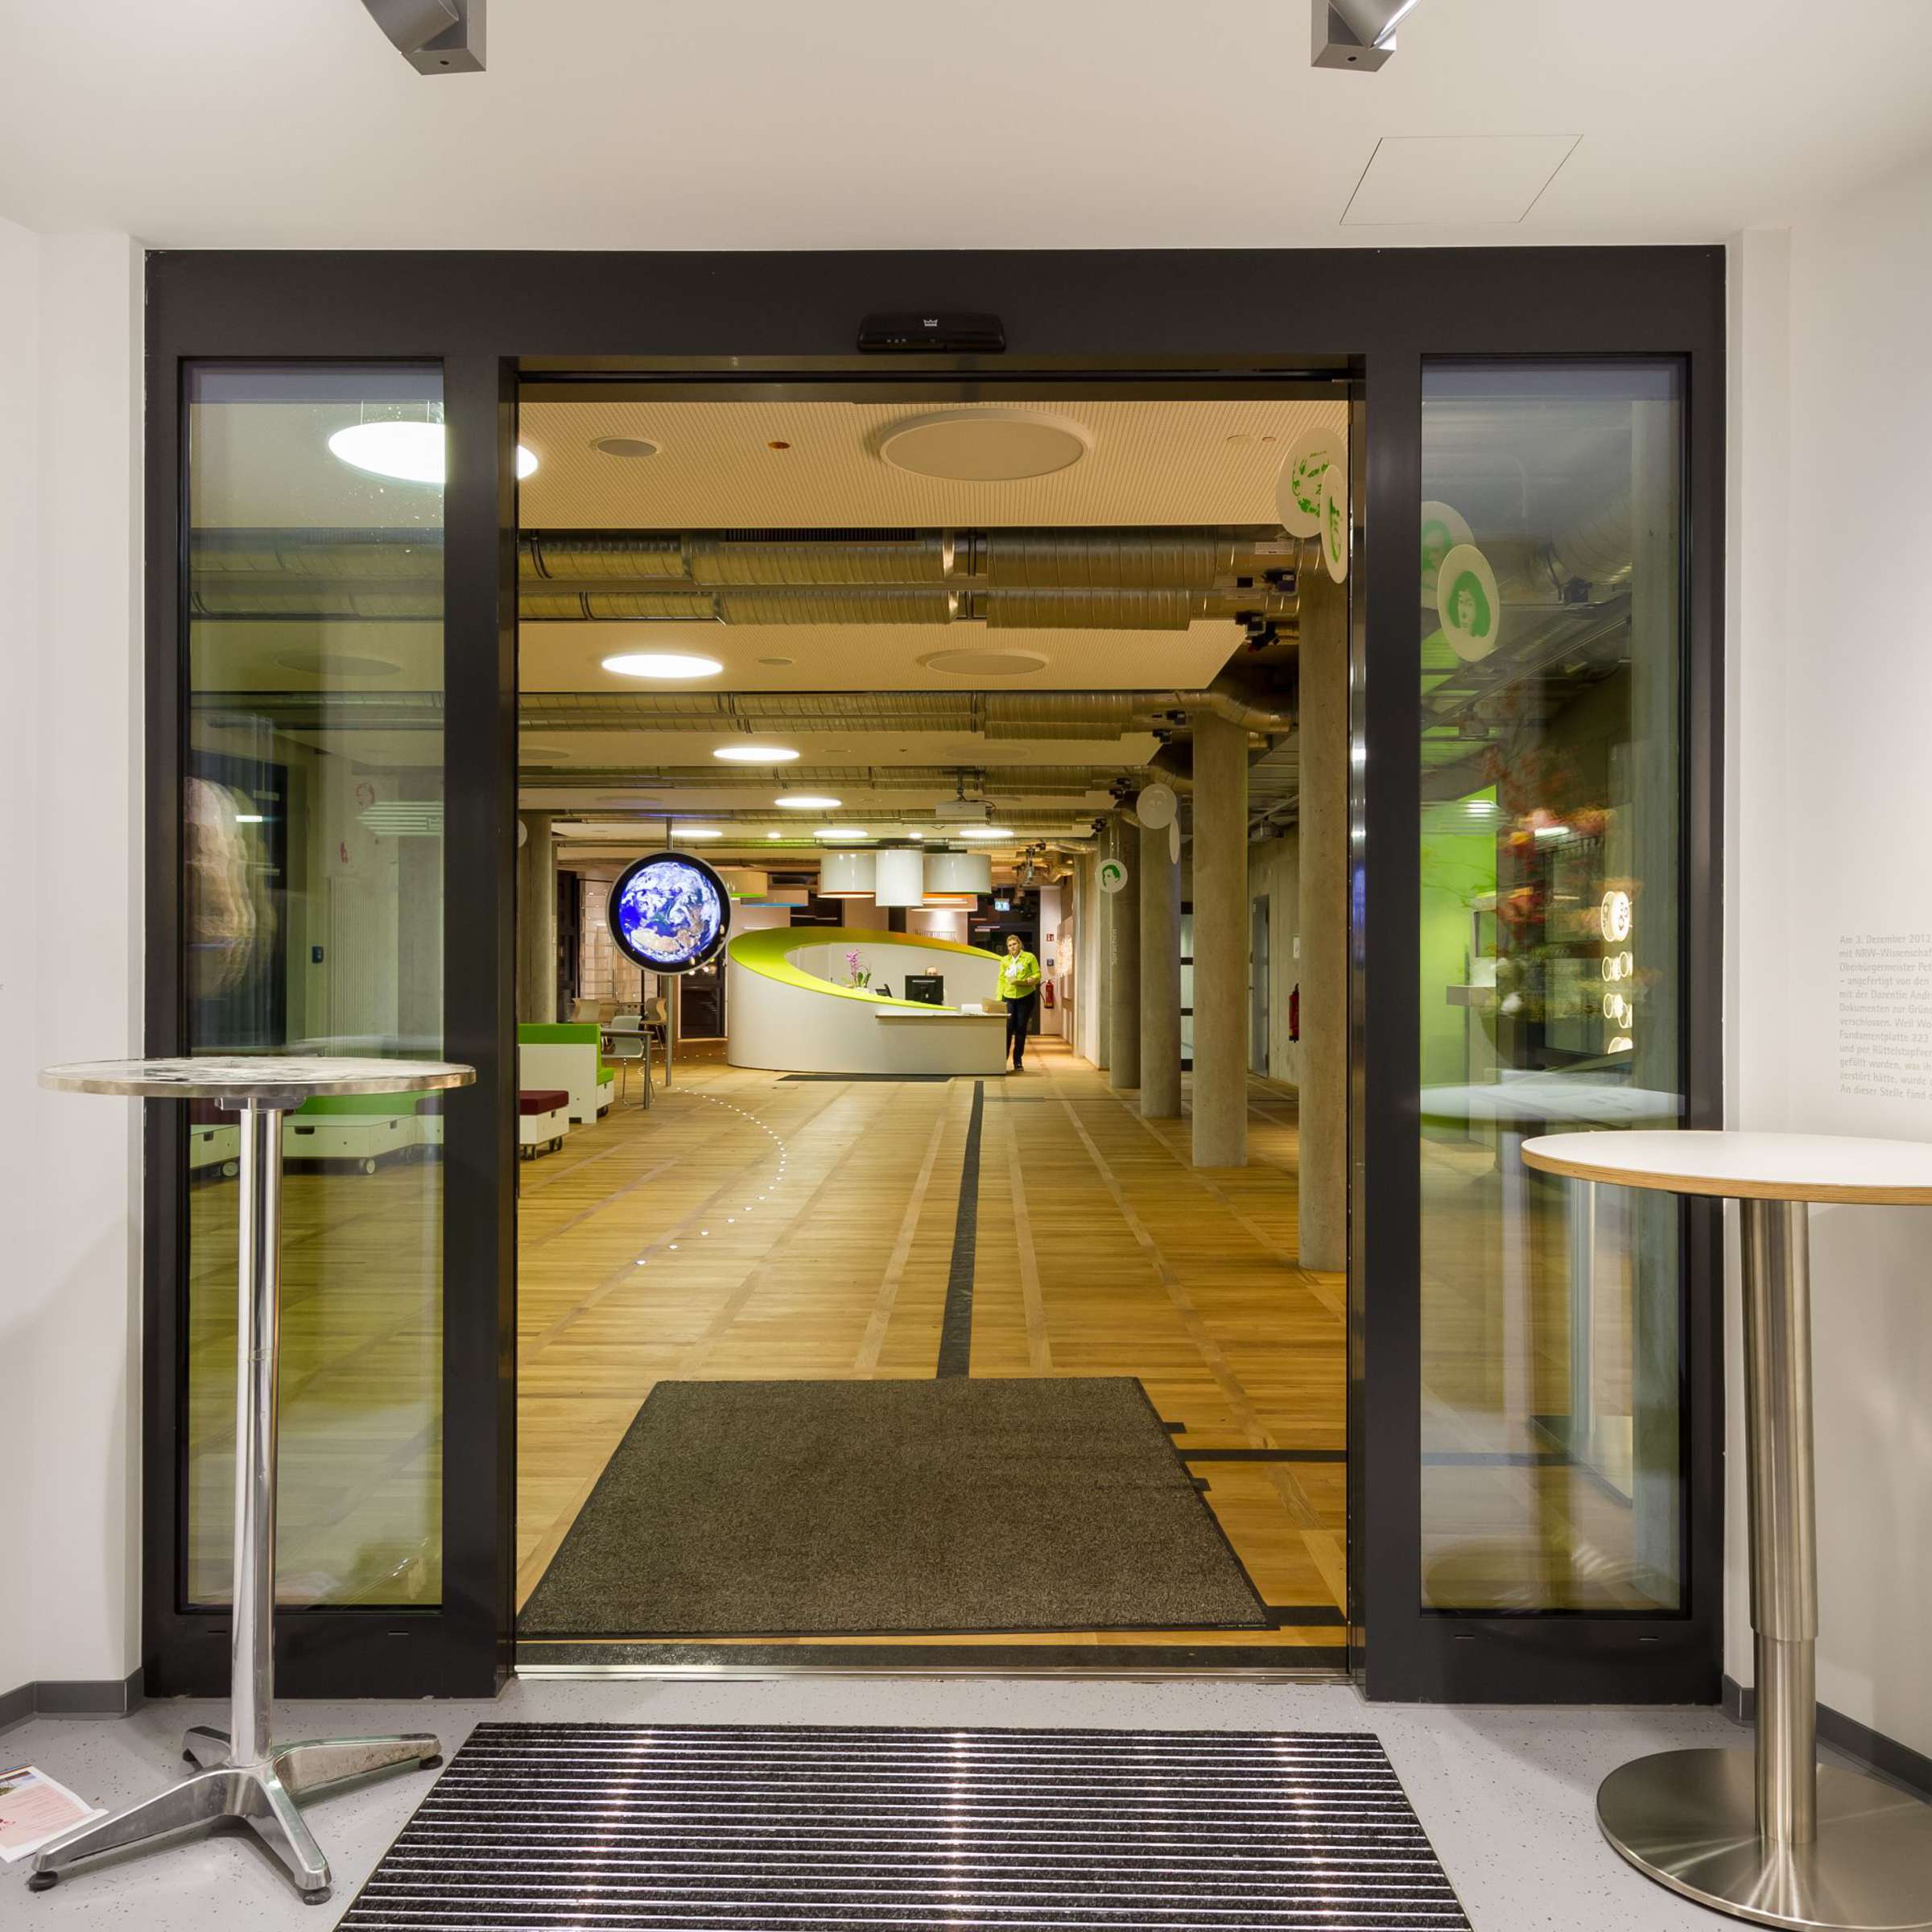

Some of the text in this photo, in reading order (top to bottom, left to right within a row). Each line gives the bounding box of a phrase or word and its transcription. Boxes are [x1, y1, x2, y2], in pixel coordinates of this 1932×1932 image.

[1839, 934, 1932, 944] Am 3. Dezember 2012
[1839, 948, 1852, 958] mit
[1839, 961, 1915, 973] Oberbürgermeister
[1847, 976, 1893, 988] angefertigt
[1913, 976, 1930, 985] den
[1839, 990, 1932, 1000] mit der Dozentin Andr
[1839, 1002, 1889, 1012] Dokumenten
[1893, 1005, 1906, 1013] zur
[1839, 1018, 1892, 1027] verschlossen.
[1894, 1018, 1913, 1028] Weil
[1839, 1030, 1909, 1043] Fundamentplatte
[1839, 1044, 1854, 1053] und
[1856, 1045, 1870, 1055] per
[1839, 1071, 1871, 1081] zerstört
[1901, 1075, 1926, 1085] wurde
[1839, 1084, 1852, 1094] An
[1853, 1085, 1877, 1096] dieser
[1880, 1087, 1904, 1098] Stelle
[1906, 1088, 1926, 1100] fand
